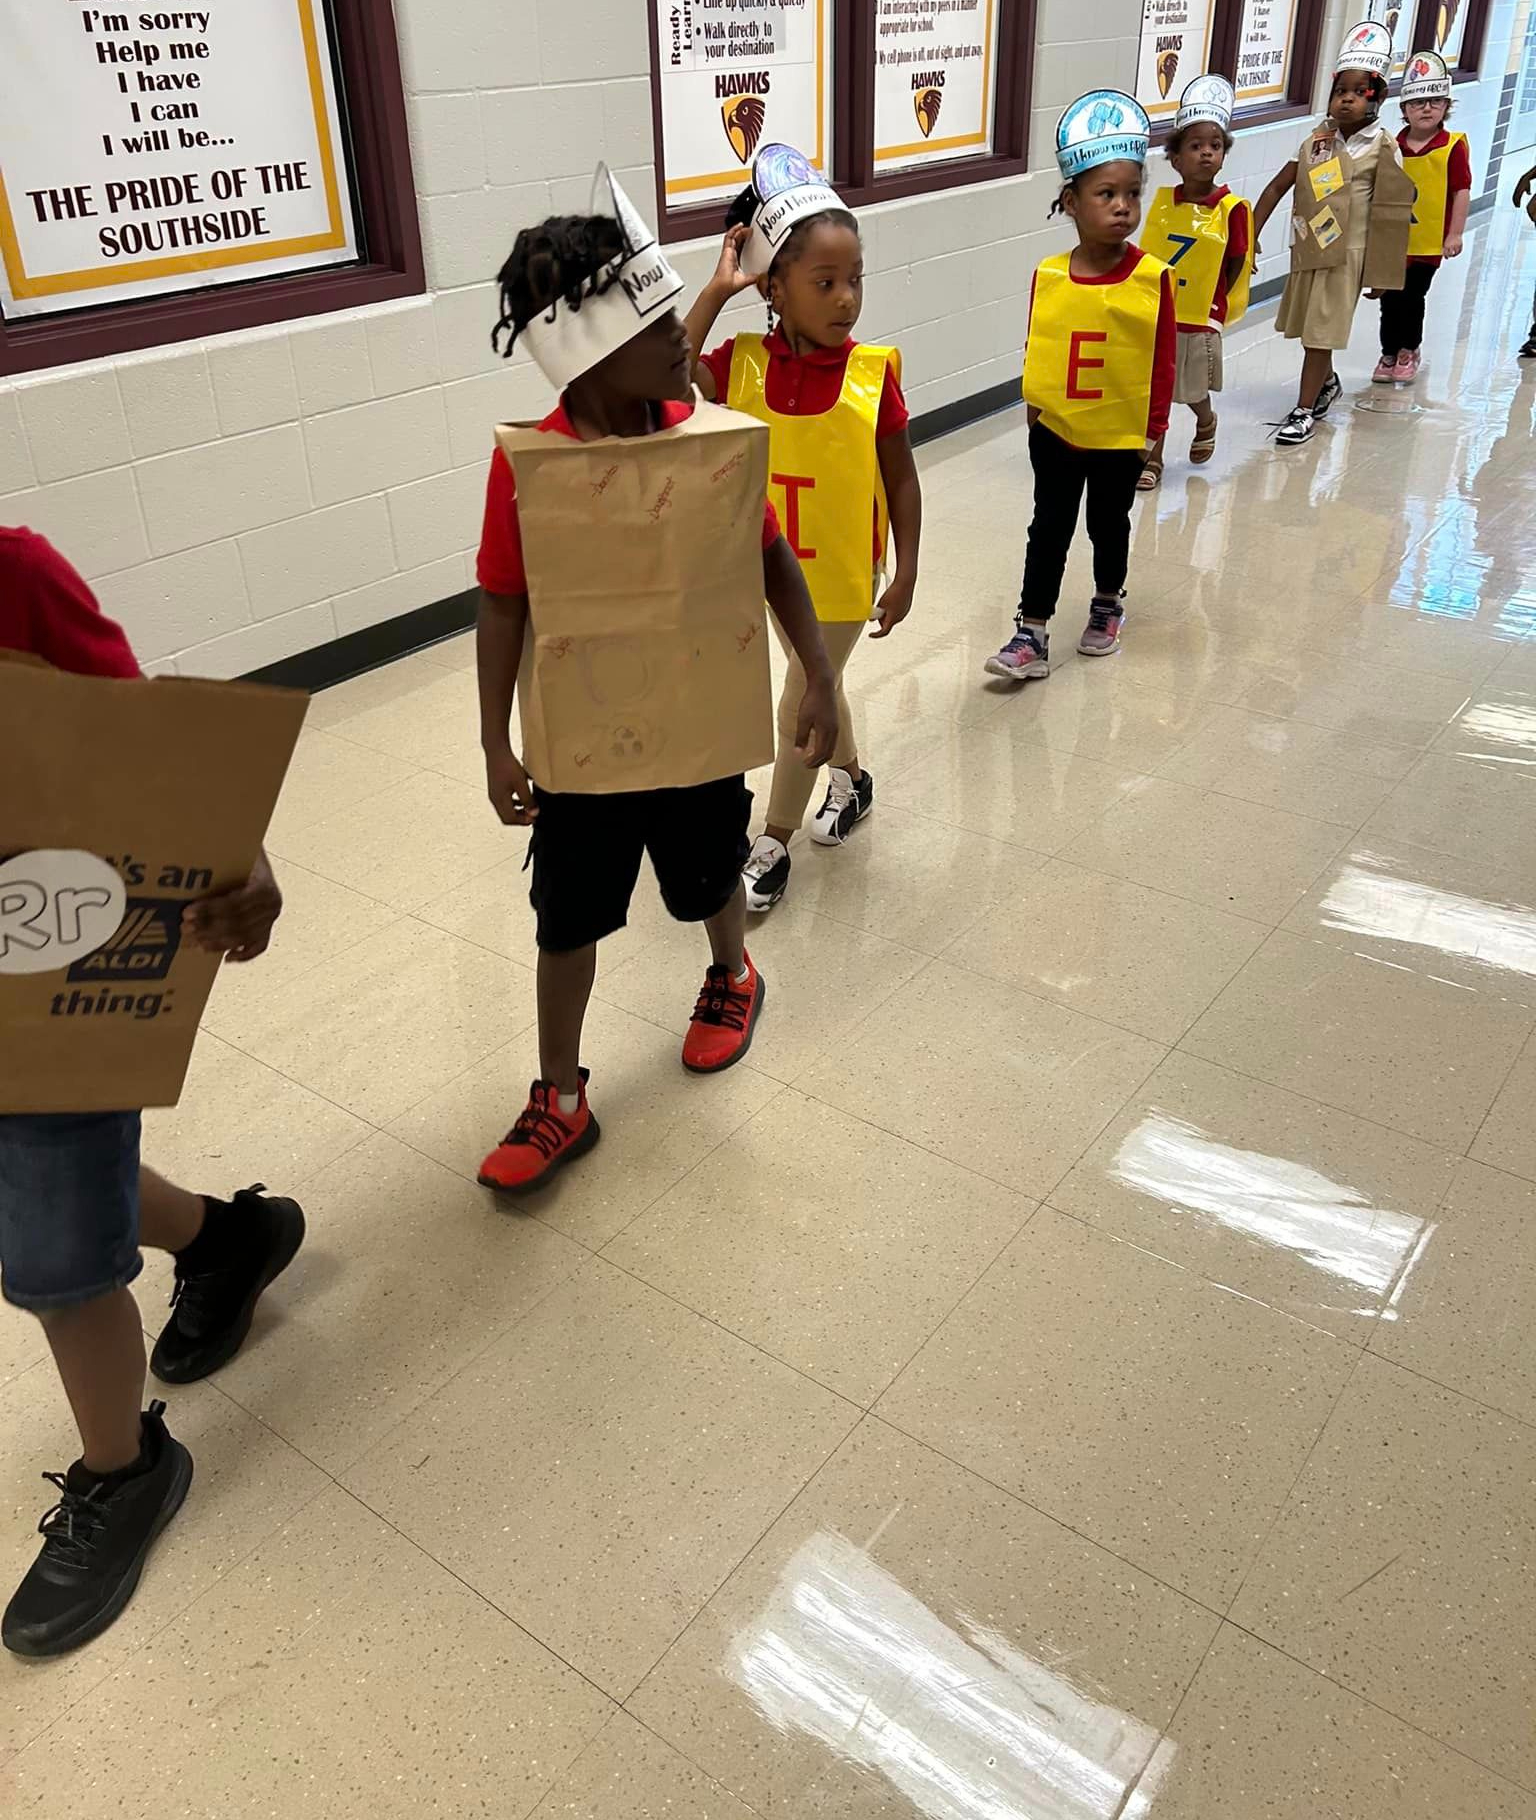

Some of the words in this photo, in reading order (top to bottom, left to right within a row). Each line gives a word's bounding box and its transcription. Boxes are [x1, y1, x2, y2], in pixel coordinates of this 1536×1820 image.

[726, 0, 735, 11] up
[139, 12, 210, 33] sorry
[704, 22, 725, 39] Walk
[728, 21, 759, 40] directly
[764, 21, 772, 36] to
[670, 5, 681, 65] Ready
[1156, 35, 1183, 53] HAWKS
[96, 40, 160, 66] Help
[169, 41, 209, 60] me
[705, 45, 725, 62] your
[728, 40, 775, 57] destination
[1262, 51, 1270, 66] OF
[1272, 50, 1283, 64] THE
[117, 72, 128, 93] I
[137, 71, 200, 92] have
[715, 71, 770, 98] HAWKS
[911, 70, 945, 90] HAWKS
[130, 102, 141, 123] I
[151, 101, 199, 121] can
[103, 135, 113, 155] I
[121, 129, 169, 153] will
[178, 128, 234, 149] be...
[1074, 151, 1079, 164] I
[1080, 145, 1109, 161] know
[1112, 142, 1128, 153] my
[26, 185, 98, 222] THE
[105, 174, 204, 214] PRIDE
[211, 168, 248, 200] OF
[255, 162, 311, 194] THE
[761, 207, 786, 237] Now
[784, 199, 794, 211] I
[99, 207, 271, 258] SOUTHSIDE
[623, 265, 664, 301] Now
[1066, 331, 1107, 399] E
[158, 865, 213, 889] an
[0, 880, 111, 957] Rr
[83, 952, 164, 970] ALDI
